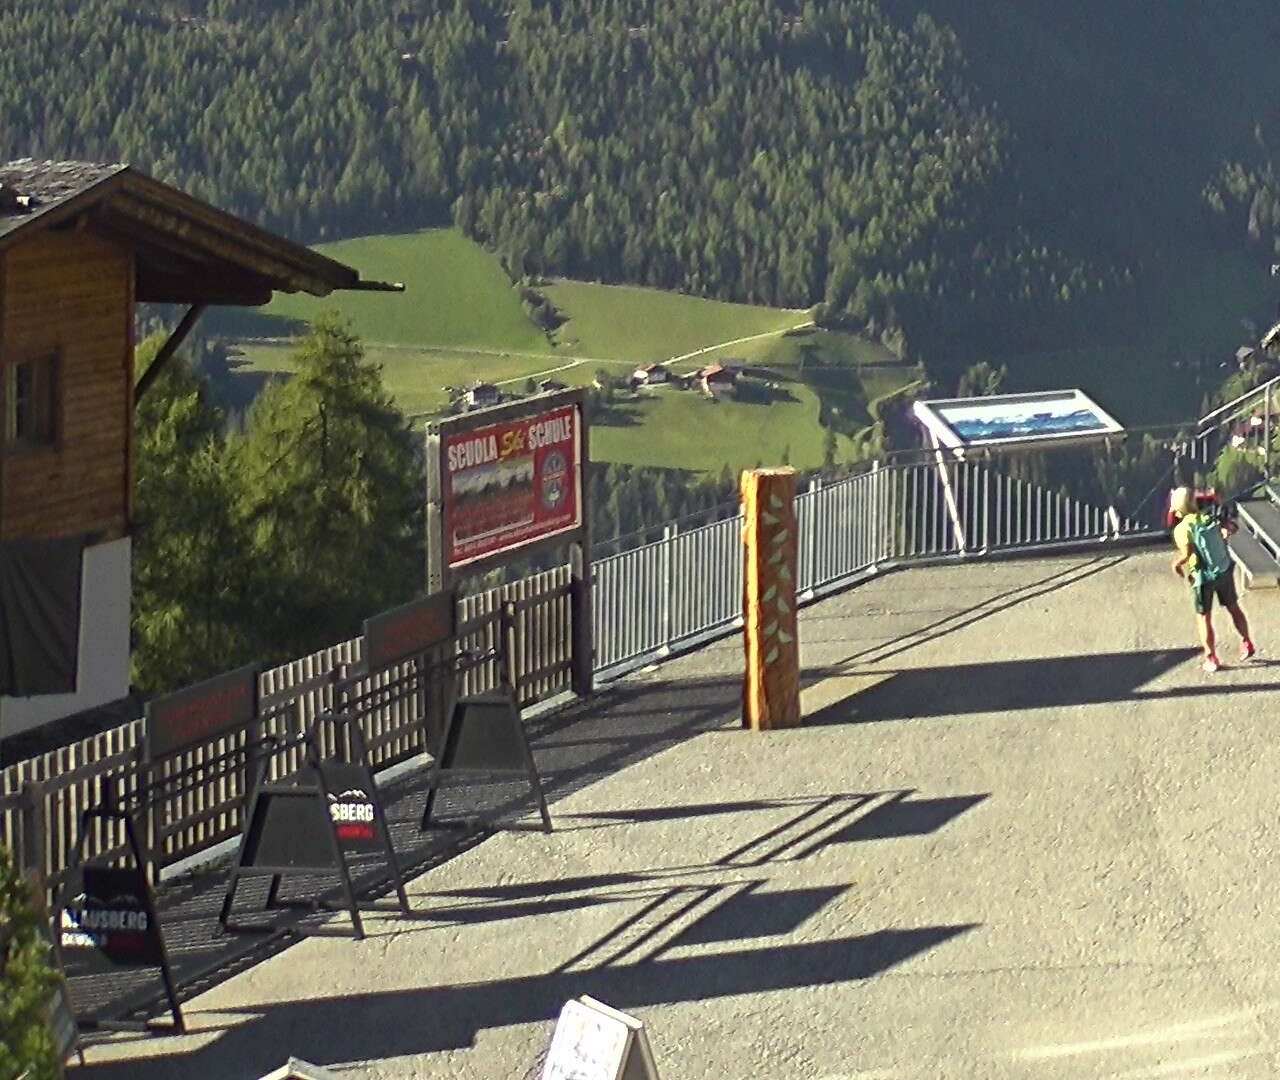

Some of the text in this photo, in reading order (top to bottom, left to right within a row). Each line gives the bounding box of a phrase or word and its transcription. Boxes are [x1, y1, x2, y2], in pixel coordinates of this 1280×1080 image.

[448, 435, 498, 471] SCUOLA
[528, 415, 572, 450] SCHULE
[329, 803, 374, 822] SBERG
